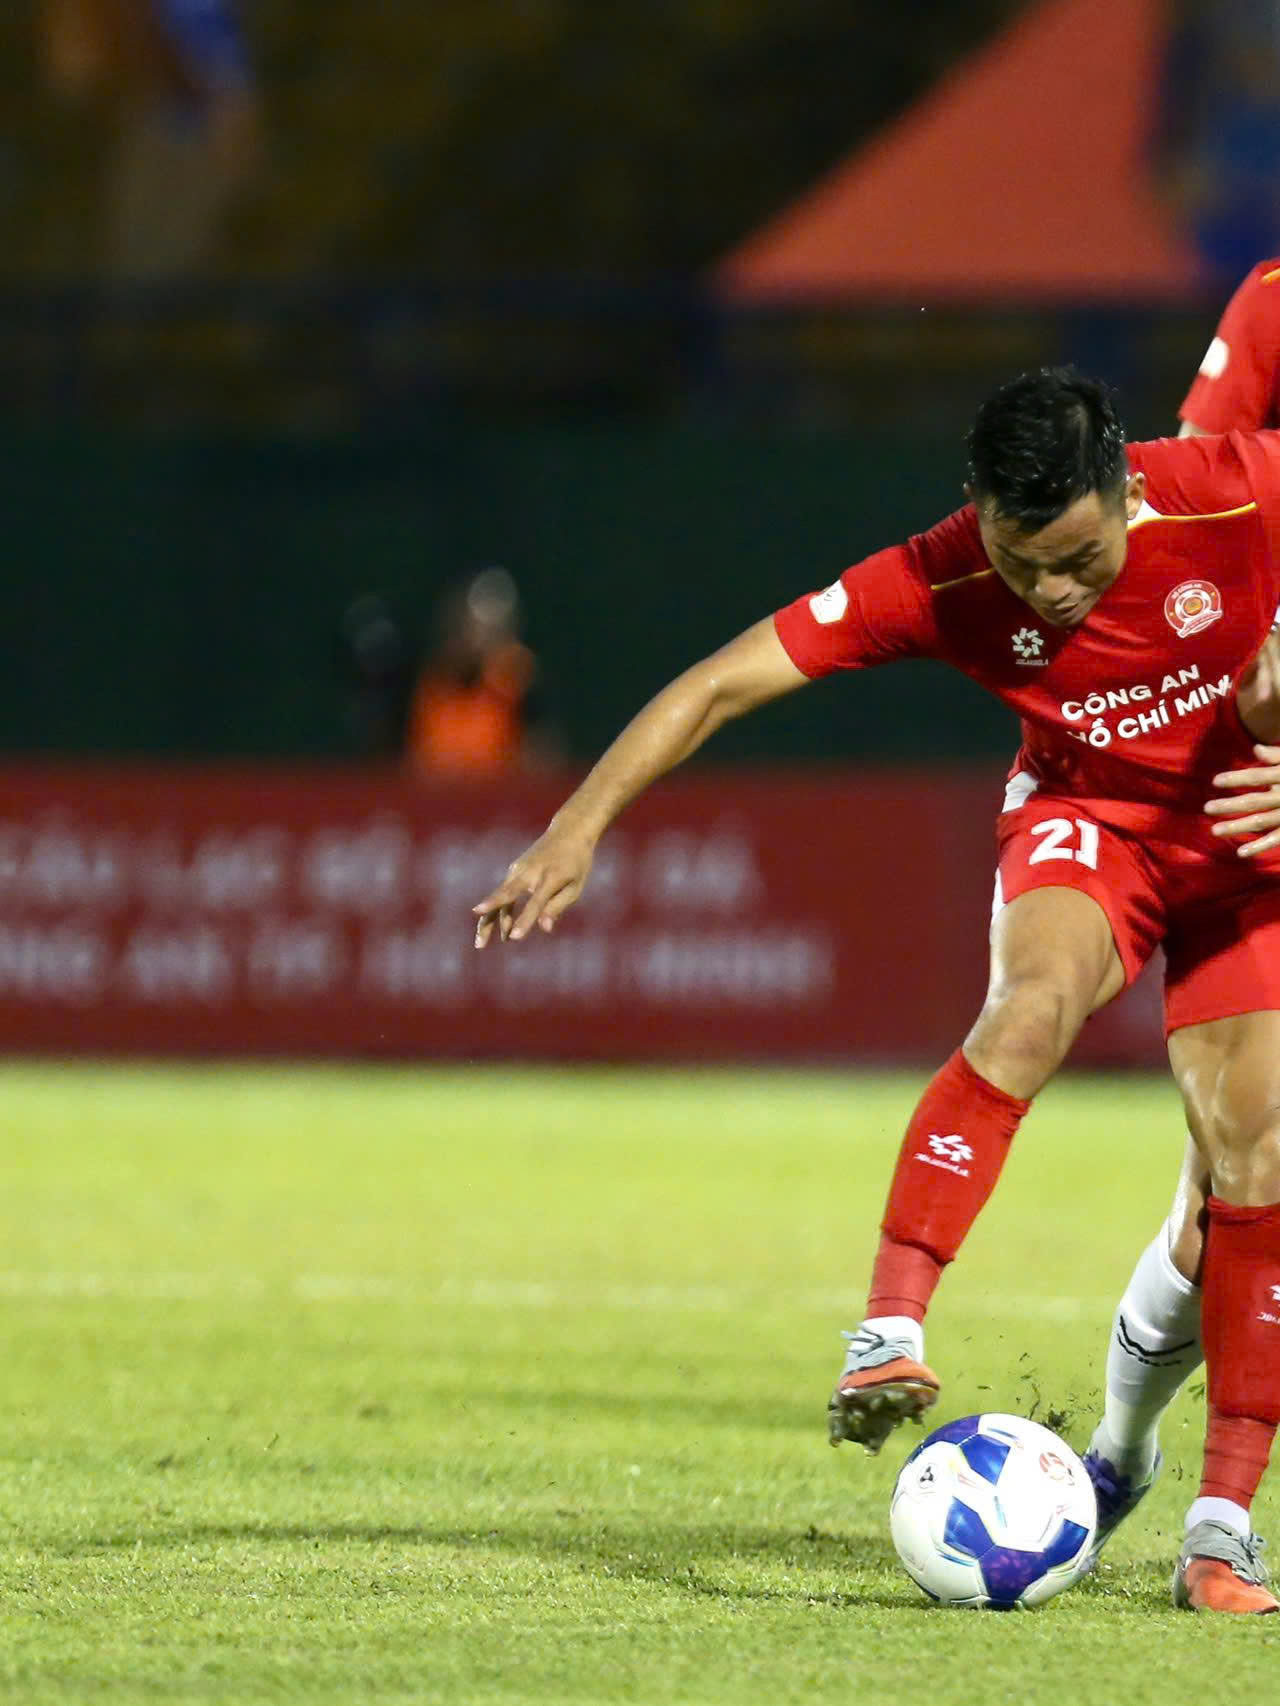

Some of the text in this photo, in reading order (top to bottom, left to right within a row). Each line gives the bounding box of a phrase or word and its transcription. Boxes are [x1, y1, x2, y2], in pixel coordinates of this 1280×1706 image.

[1061, 664, 1200, 721] CÔNG AN
[1117, 699, 1170, 739] CHÍ
[1028, 818, 1099, 870] 21
